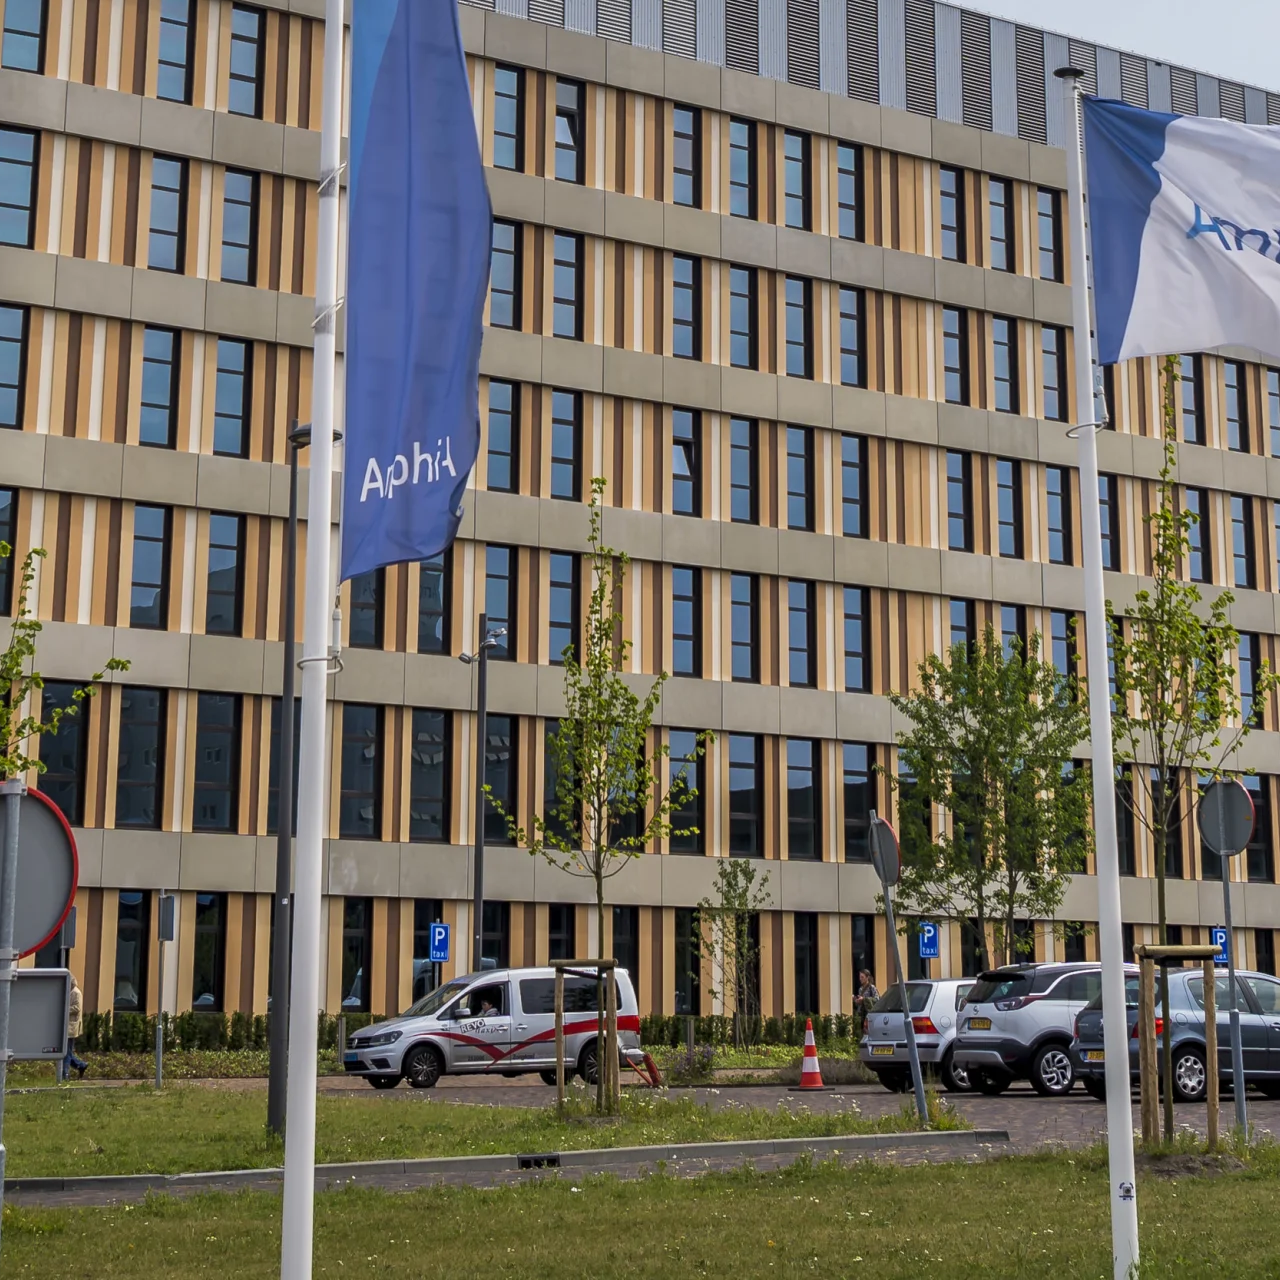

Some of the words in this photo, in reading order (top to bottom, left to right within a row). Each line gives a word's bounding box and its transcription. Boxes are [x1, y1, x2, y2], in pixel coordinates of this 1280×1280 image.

[360, 436, 457, 502] Aphi
[435, 927, 446, 946] P
[924, 925, 935, 943] P
[1216, 932, 1226, 946] P
[432, 950, 448, 958] taxi
[461, 1019, 485, 1033] REVO
